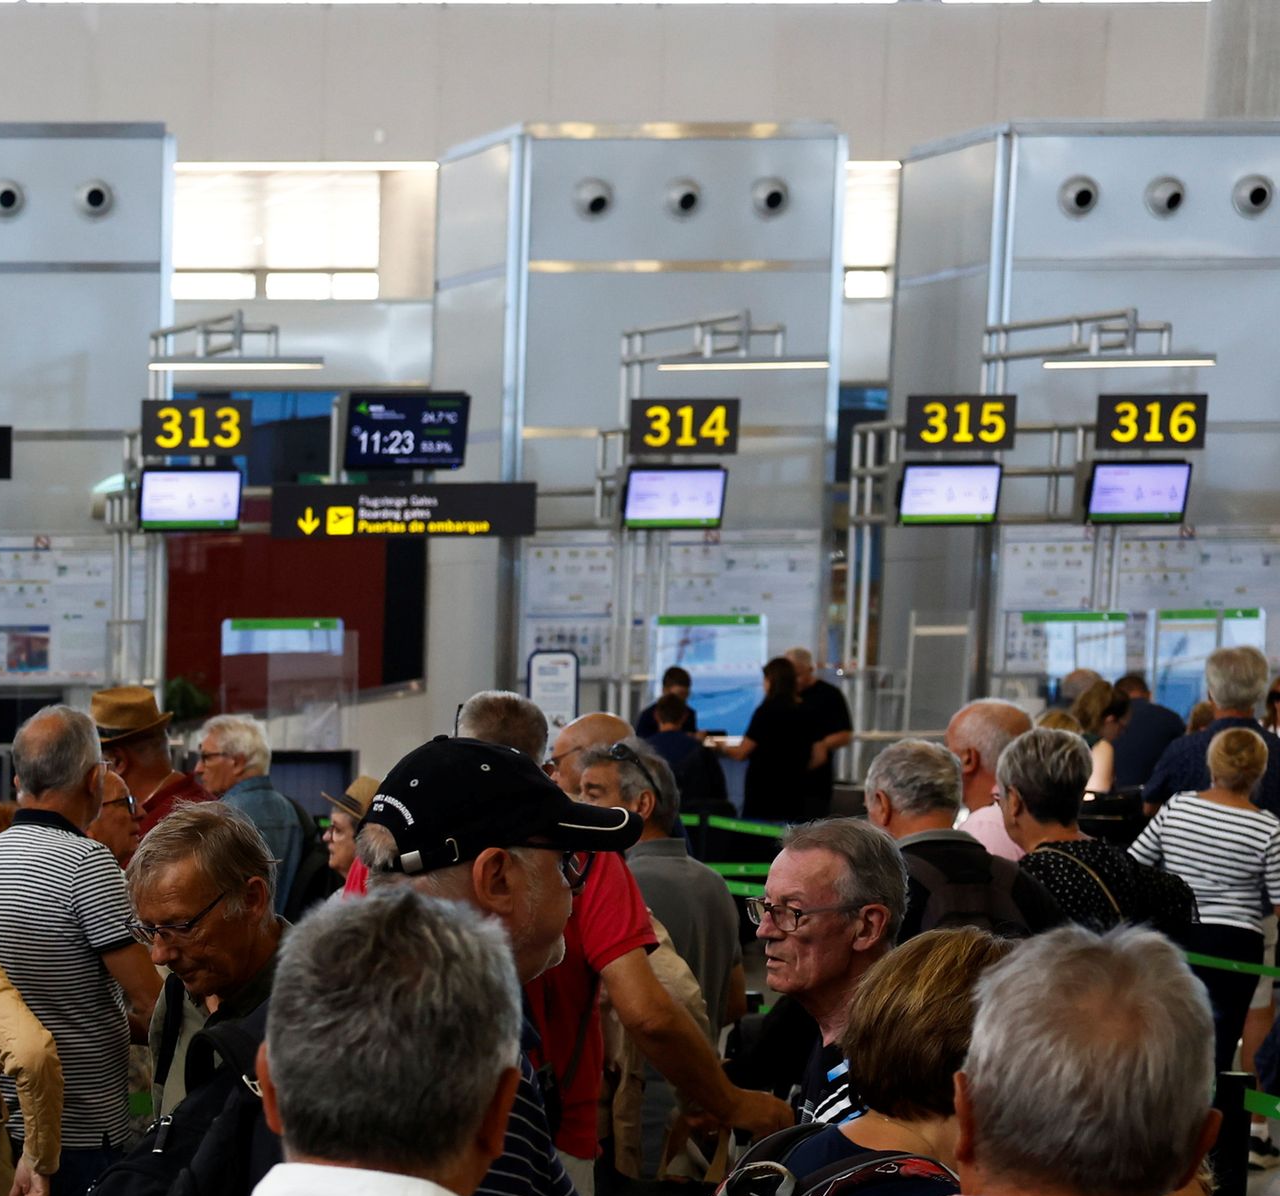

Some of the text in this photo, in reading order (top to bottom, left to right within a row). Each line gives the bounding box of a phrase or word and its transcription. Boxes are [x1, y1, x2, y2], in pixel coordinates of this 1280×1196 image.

[155, 406, 241, 449] 313
[359, 430, 415, 455] 11:23
[643, 405, 730, 447] 314
[920, 402, 1007, 444] 315
[1110, 402, 1197, 443] 316
[358, 507, 431, 521] Boarding gates
[358, 519, 490, 535] Puertas de embarque
